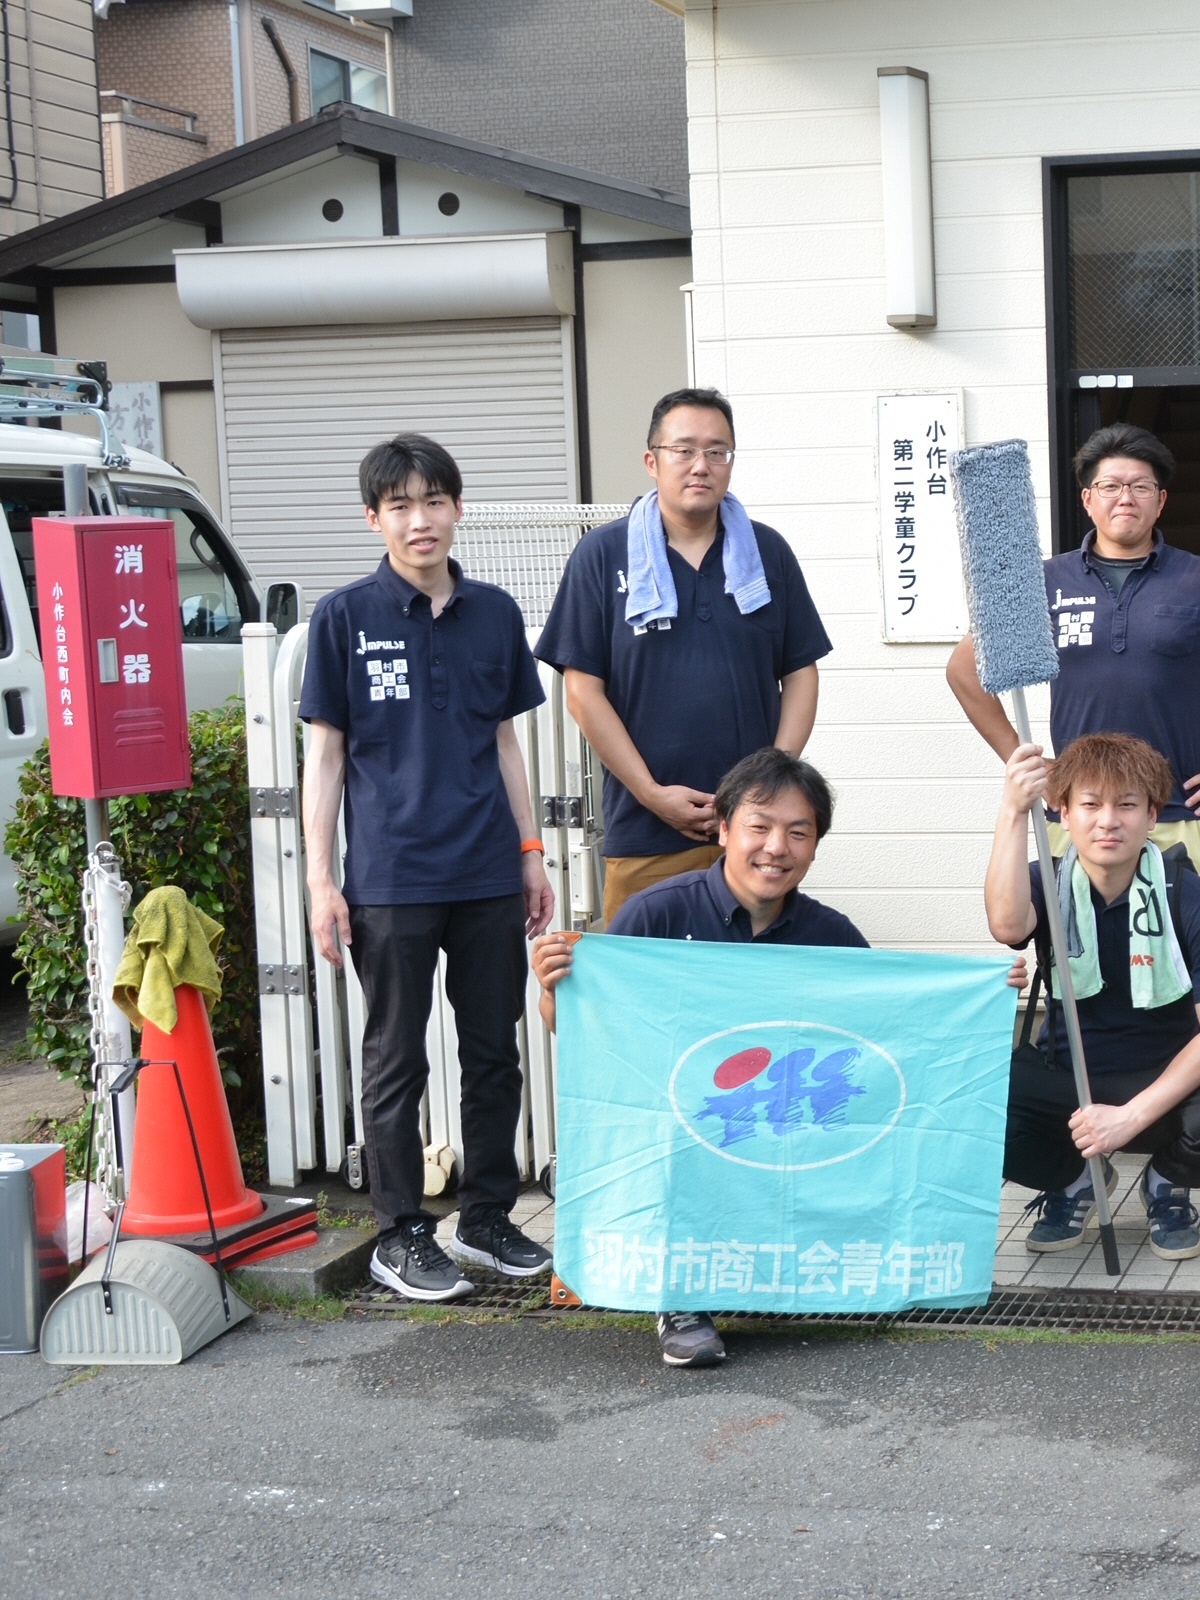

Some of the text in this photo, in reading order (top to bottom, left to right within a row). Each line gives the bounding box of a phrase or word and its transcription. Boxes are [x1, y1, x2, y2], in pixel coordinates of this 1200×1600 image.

[893, 438, 919, 616] 第二学童クラブ
[925, 420, 948, 496] 小作台
[52, 582, 74, 726] 小作台西町内会
[114, 544, 152, 684] 消火器
[583, 1231, 965, 1297] 羽村市商工会青年部
